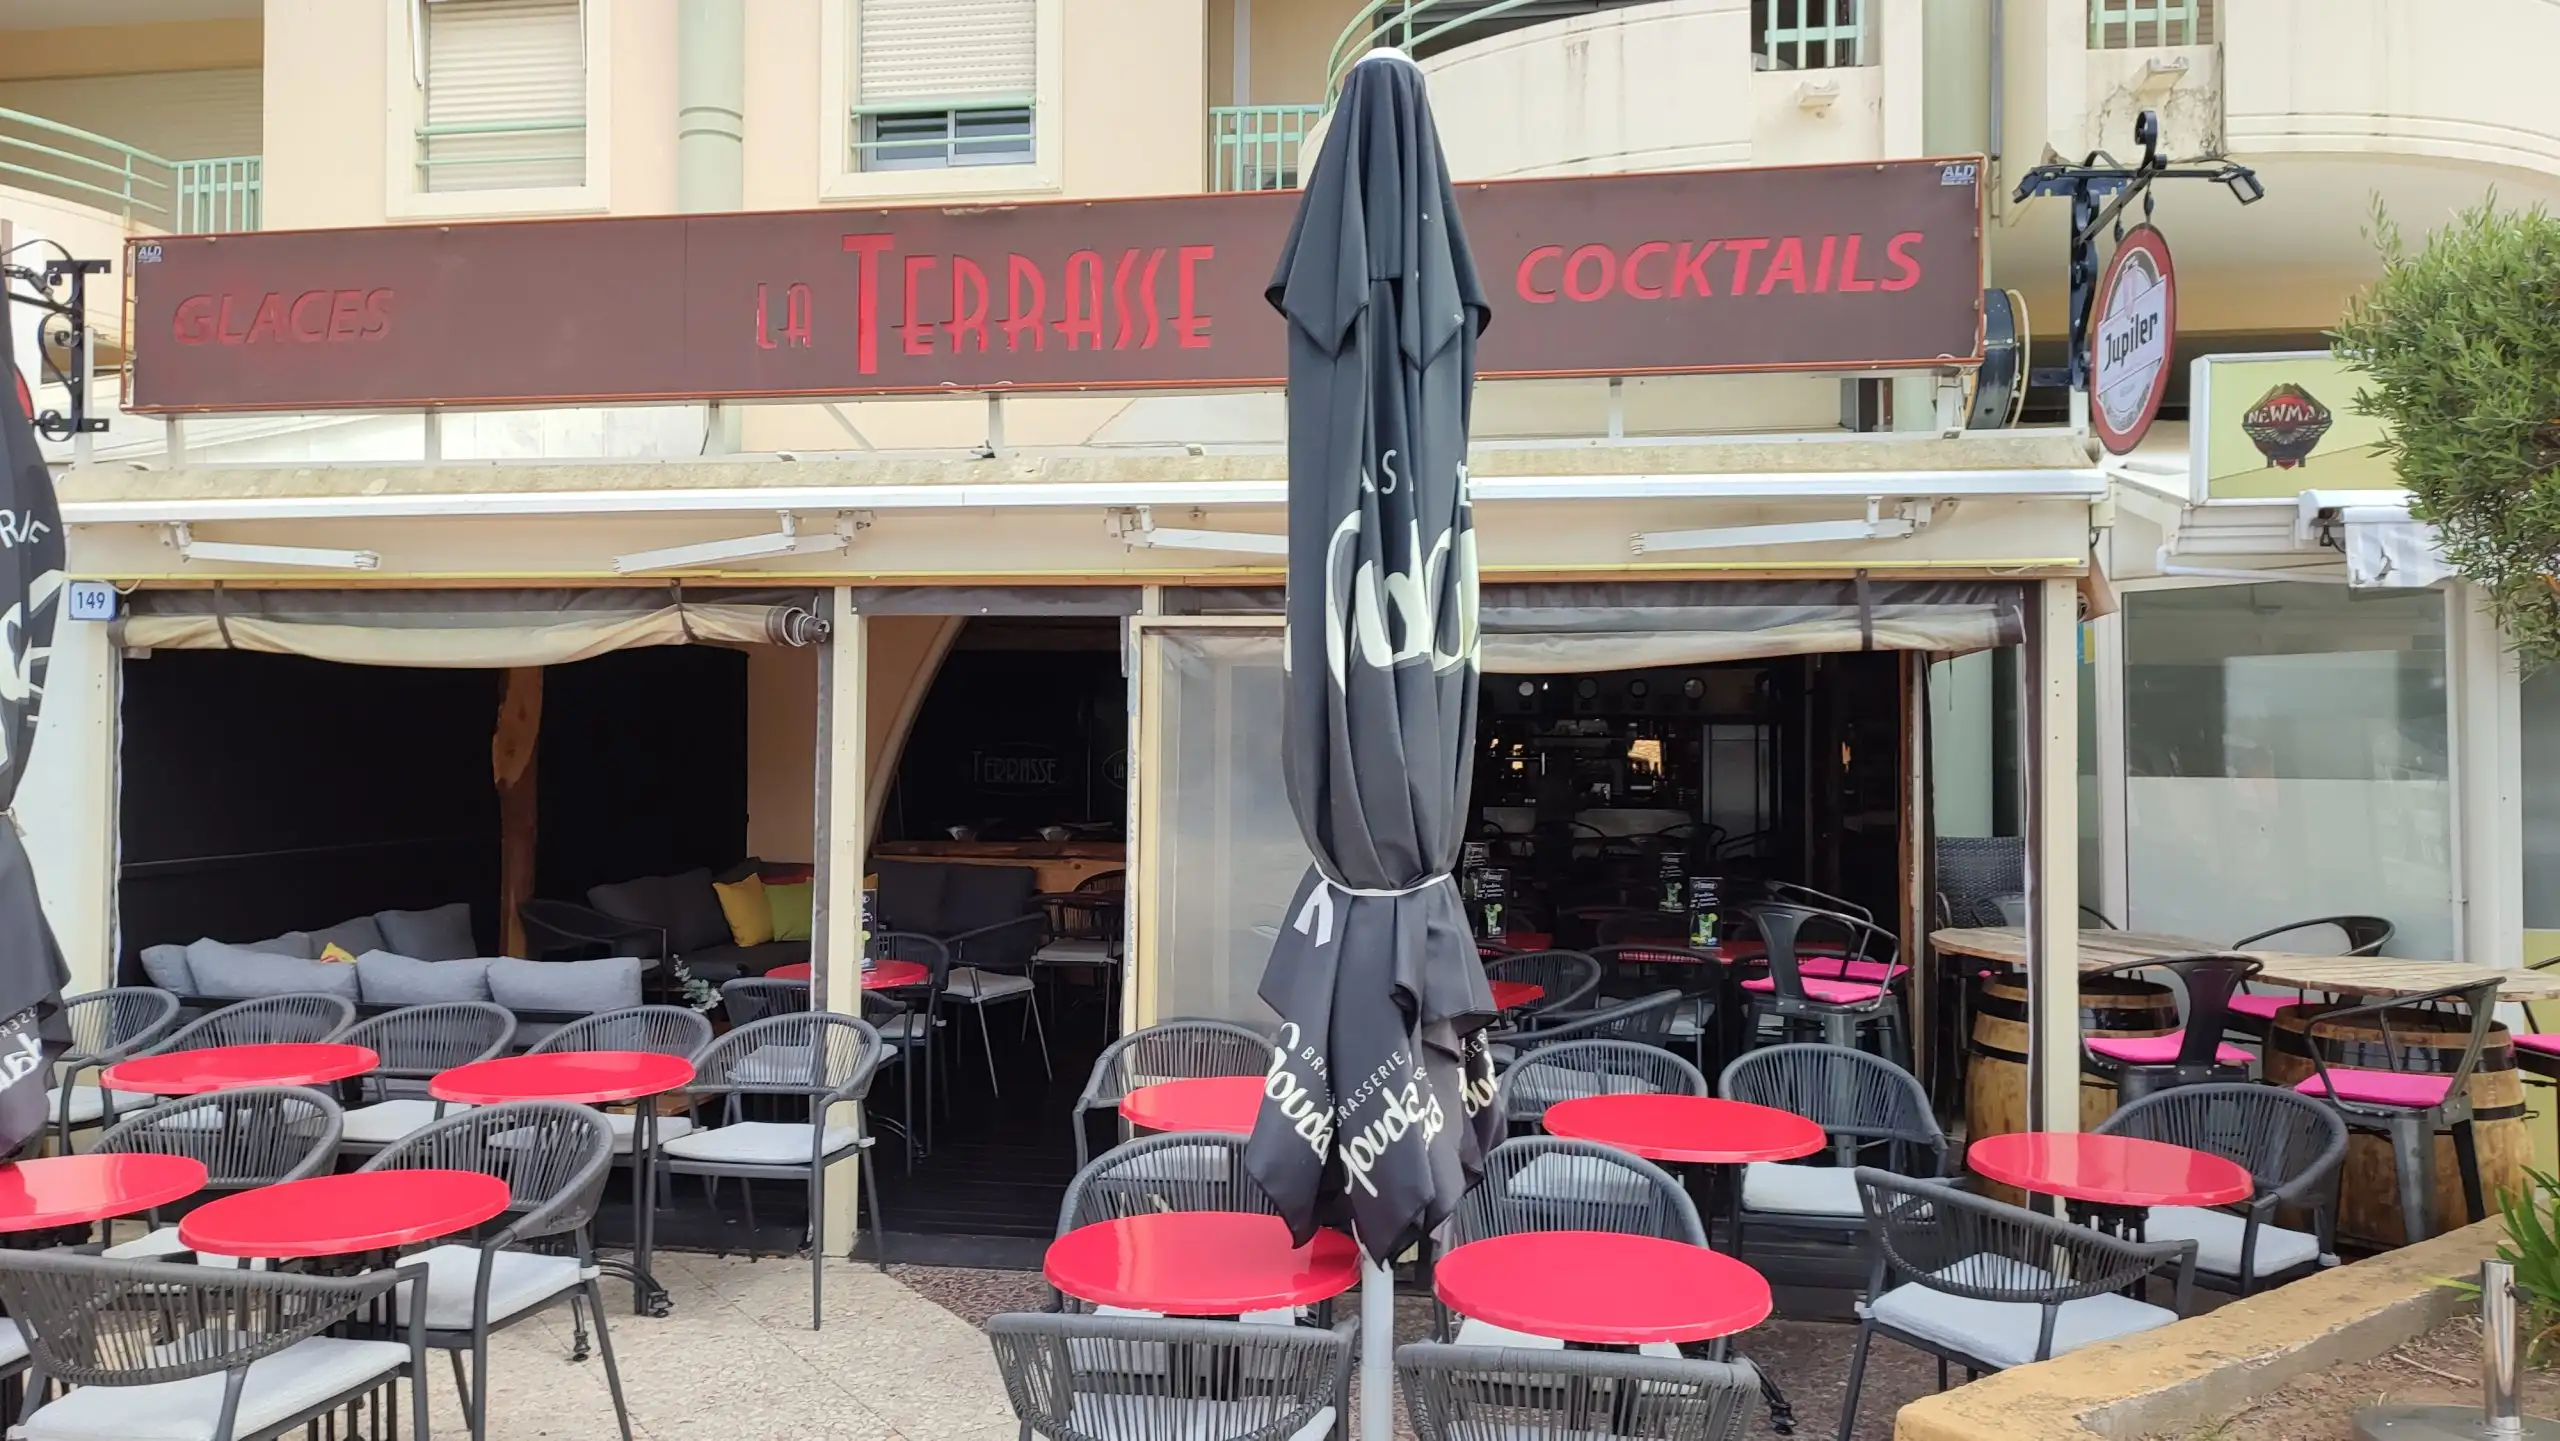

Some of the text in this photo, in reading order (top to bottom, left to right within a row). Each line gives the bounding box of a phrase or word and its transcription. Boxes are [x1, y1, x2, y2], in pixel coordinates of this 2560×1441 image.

[1942, 164, 1975, 178] ALD
[1515, 230, 1925, 304] COCKTAILS
[172, 286, 395, 346] GLACES
[755, 282, 813, 351] LA
[2102, 311, 2159, 373] Jupiler
[76, 591, 106, 610] 149
